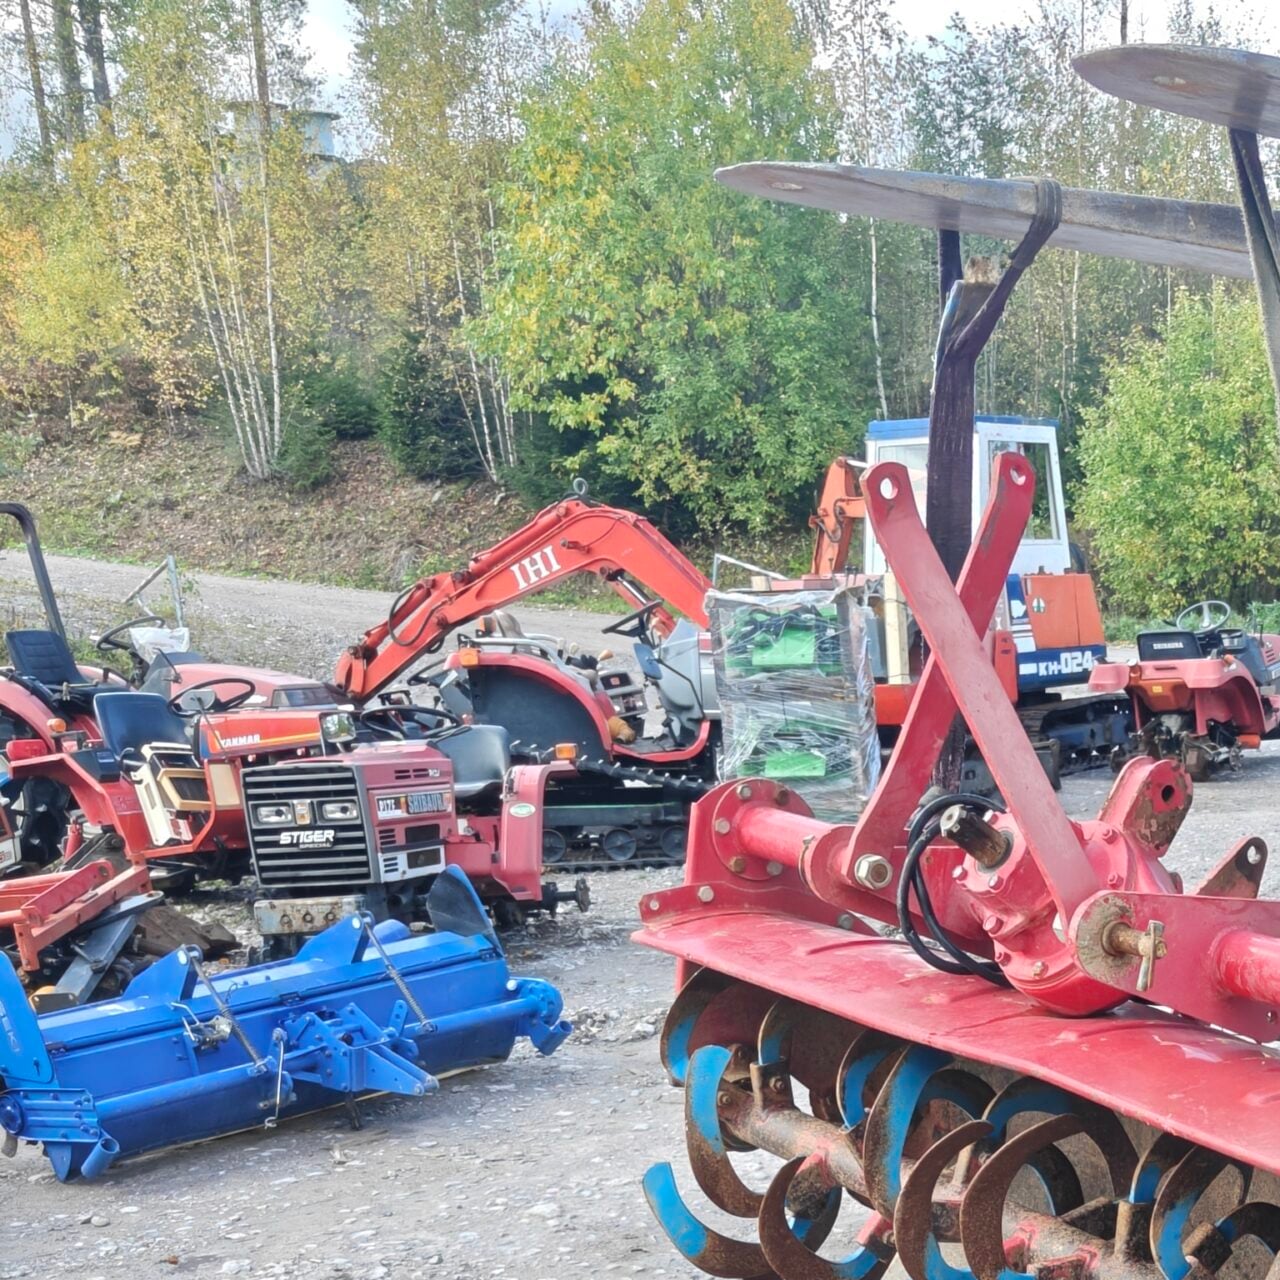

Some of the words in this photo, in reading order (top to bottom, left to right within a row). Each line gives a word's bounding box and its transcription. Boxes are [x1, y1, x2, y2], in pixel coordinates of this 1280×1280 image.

[509, 545, 561, 590] IHI
[1039, 651, 1093, 676] KH-024
[219, 734, 260, 748] YANMAR
[280, 829, 335, 845] STIGER
